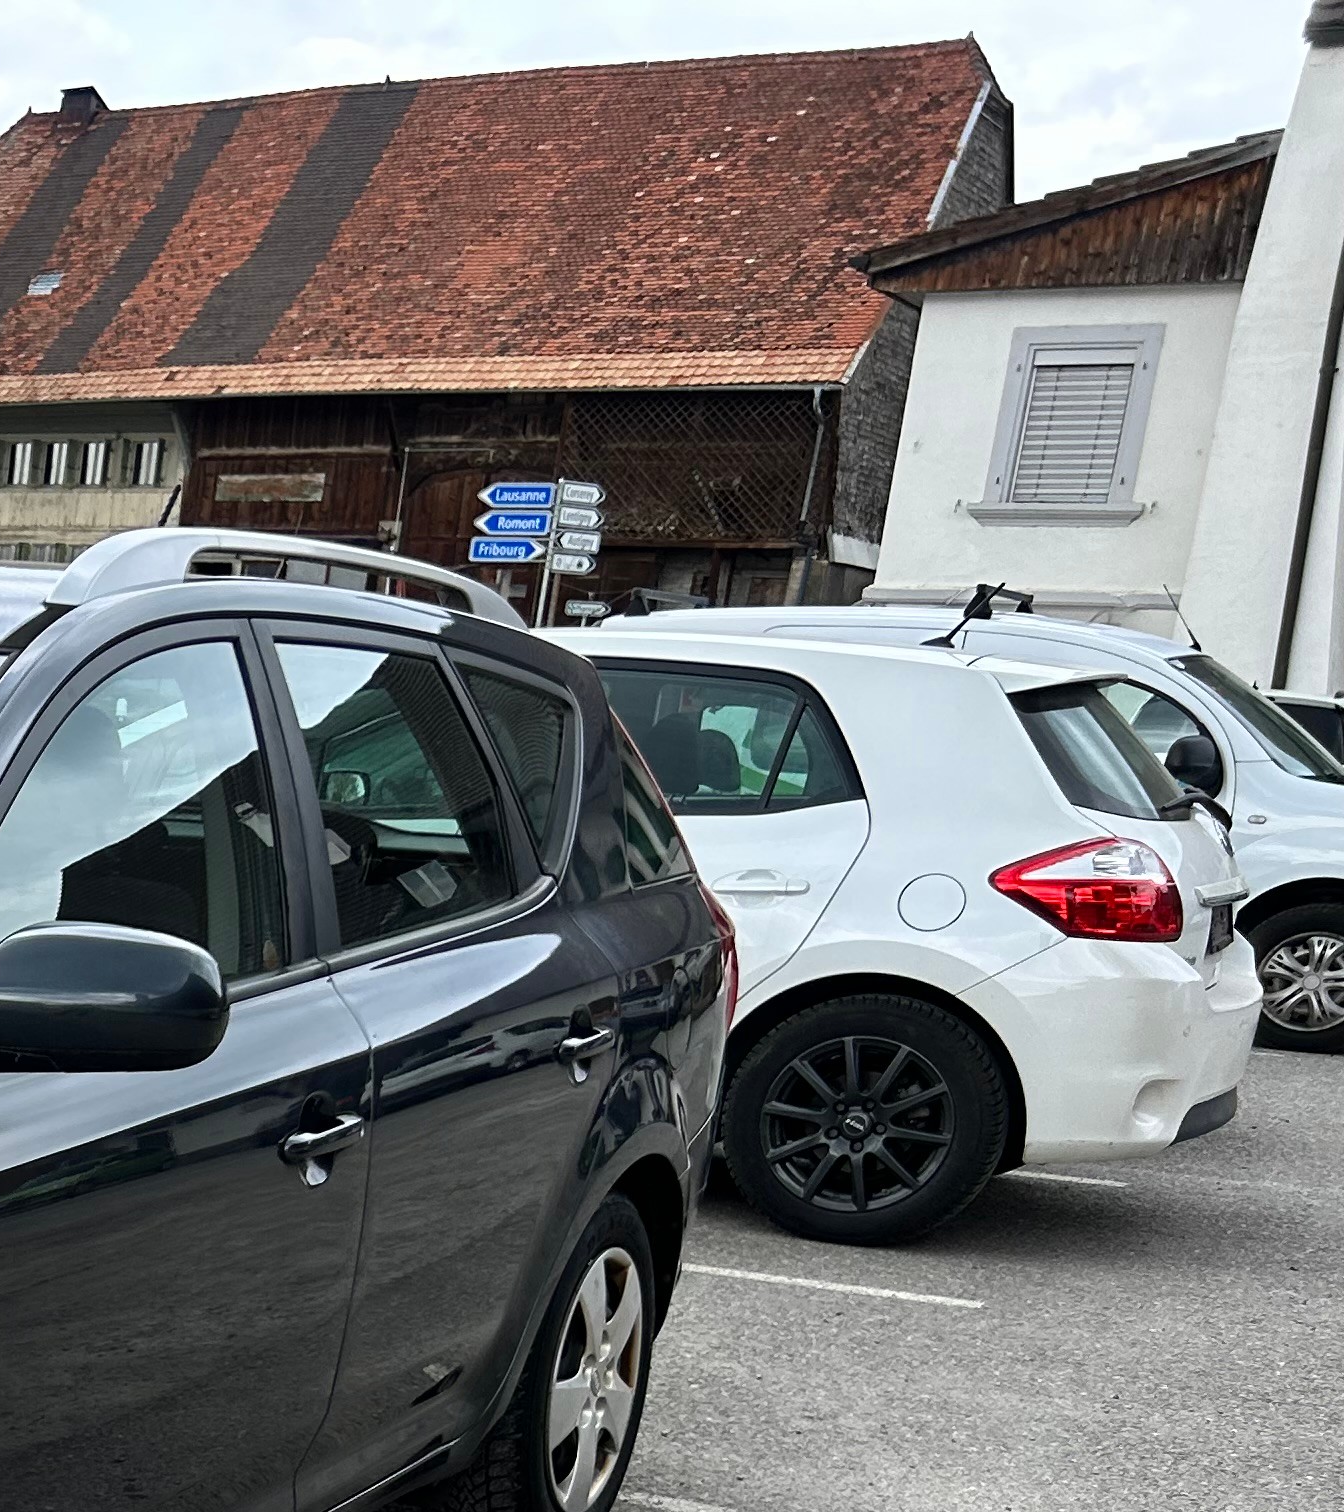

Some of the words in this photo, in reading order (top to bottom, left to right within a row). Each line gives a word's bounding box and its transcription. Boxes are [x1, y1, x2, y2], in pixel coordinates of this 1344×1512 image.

[495, 489, 547, 502] Lausanne
[497, 516, 541, 530] Romont
[478, 542, 526, 560] Fribourg
